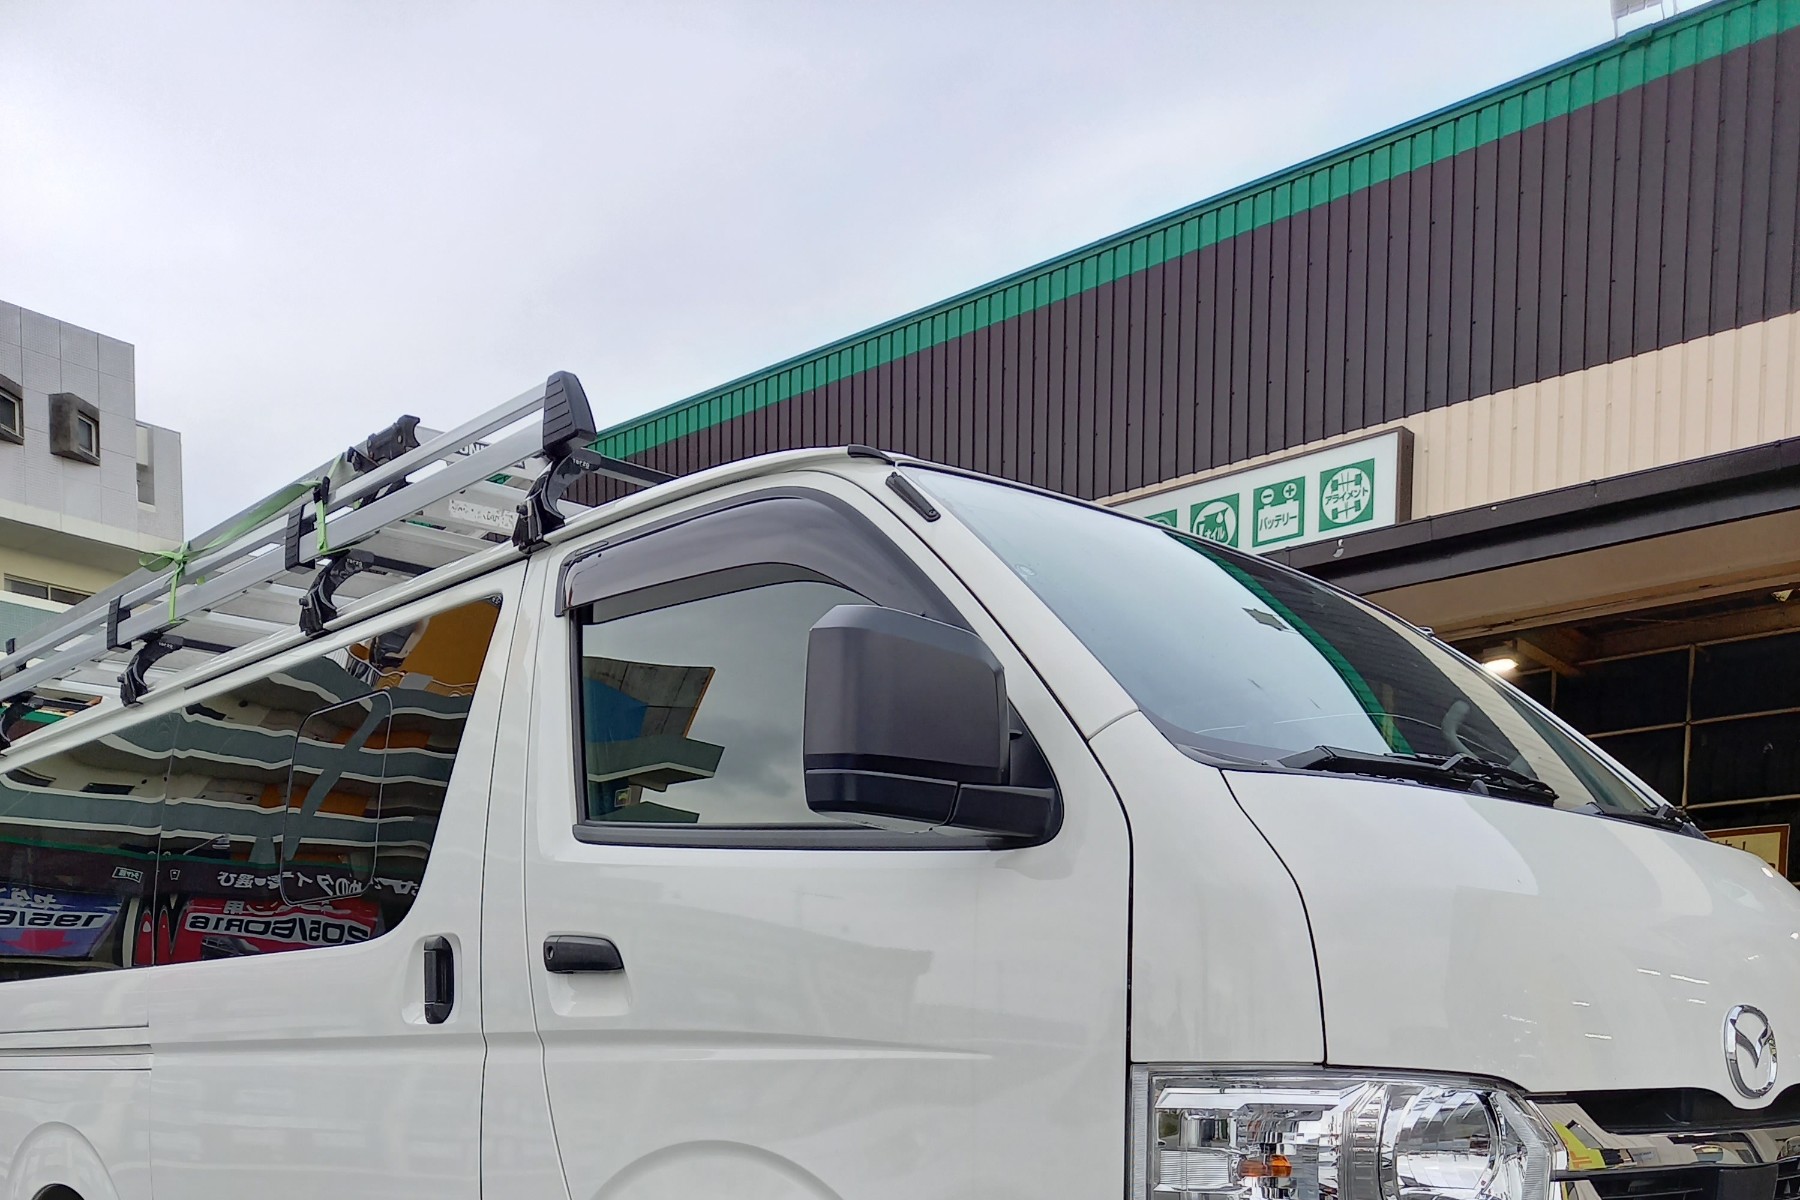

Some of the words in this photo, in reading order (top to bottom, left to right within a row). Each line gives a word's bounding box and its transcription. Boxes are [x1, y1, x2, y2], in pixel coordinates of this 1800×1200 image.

[1325, 487, 1369, 505] アライメント
[1260, 512, 1298, 531] バッテリー
[1204, 526, 1226, 541] オイル
